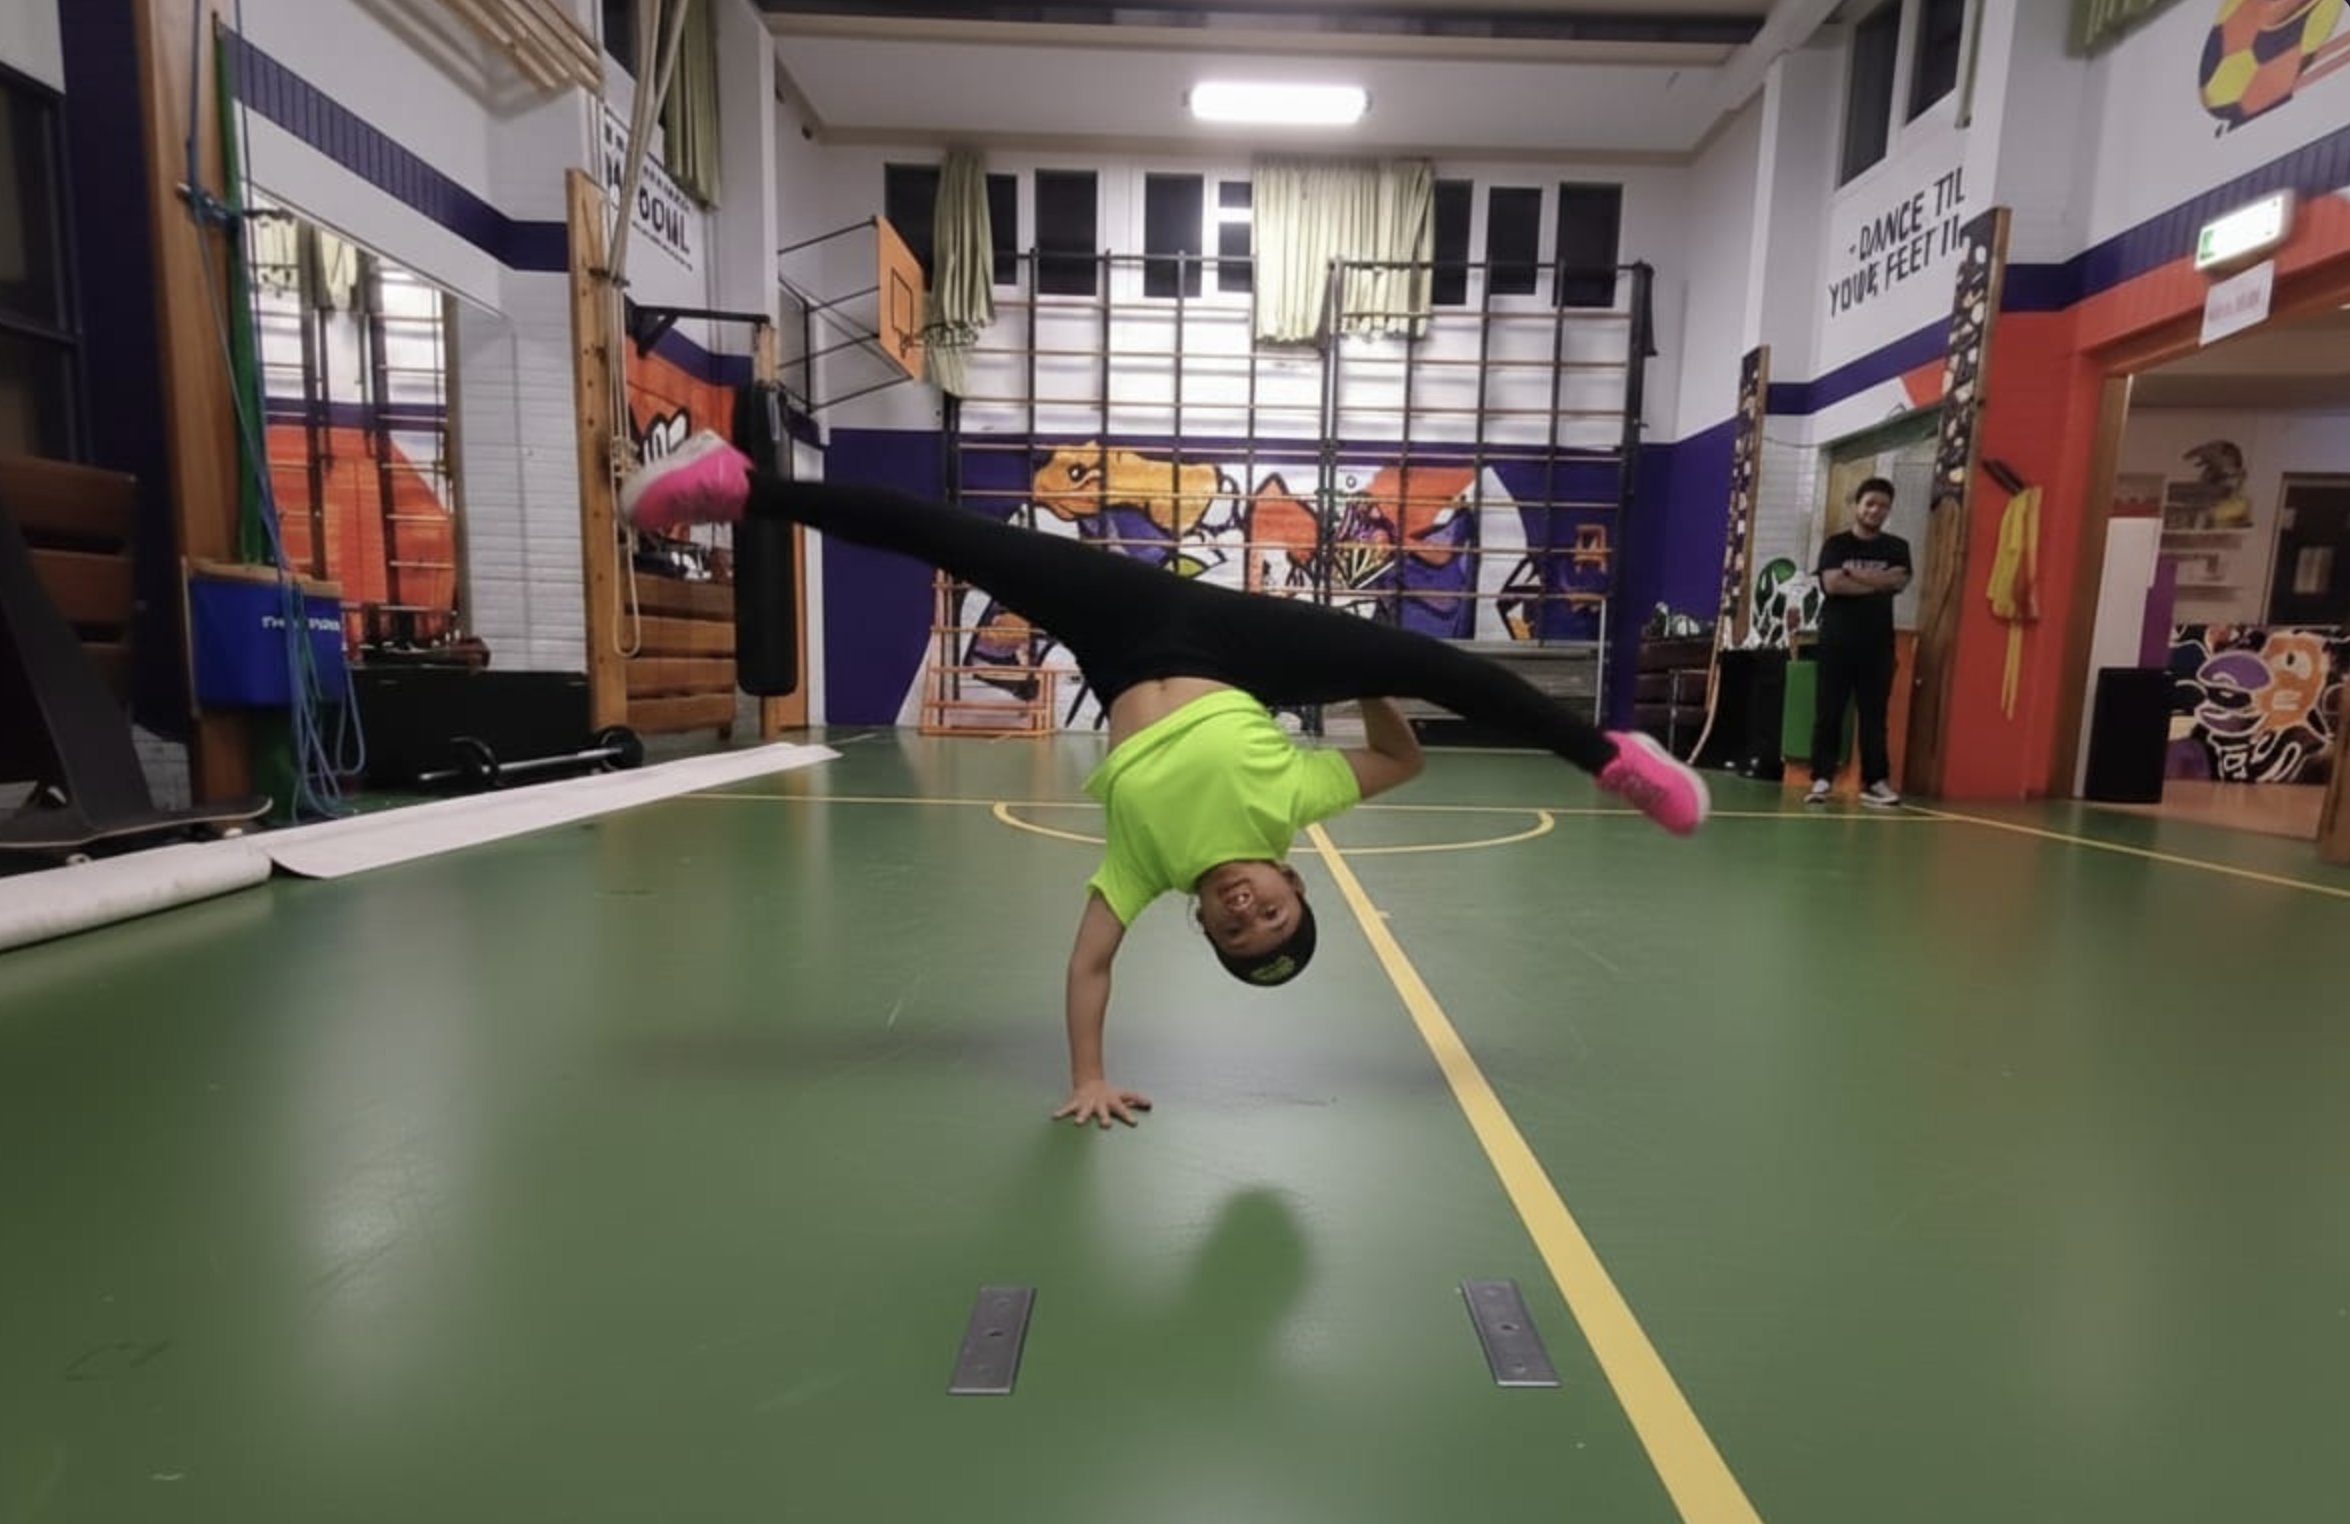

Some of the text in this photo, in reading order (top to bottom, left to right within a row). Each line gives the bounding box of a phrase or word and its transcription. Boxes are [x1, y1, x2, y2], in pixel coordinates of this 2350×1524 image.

[1859, 190, 1925, 261] DANCE
[1934, 167, 1965, 217] TIL
[1885, 227, 1938, 291] FEET
